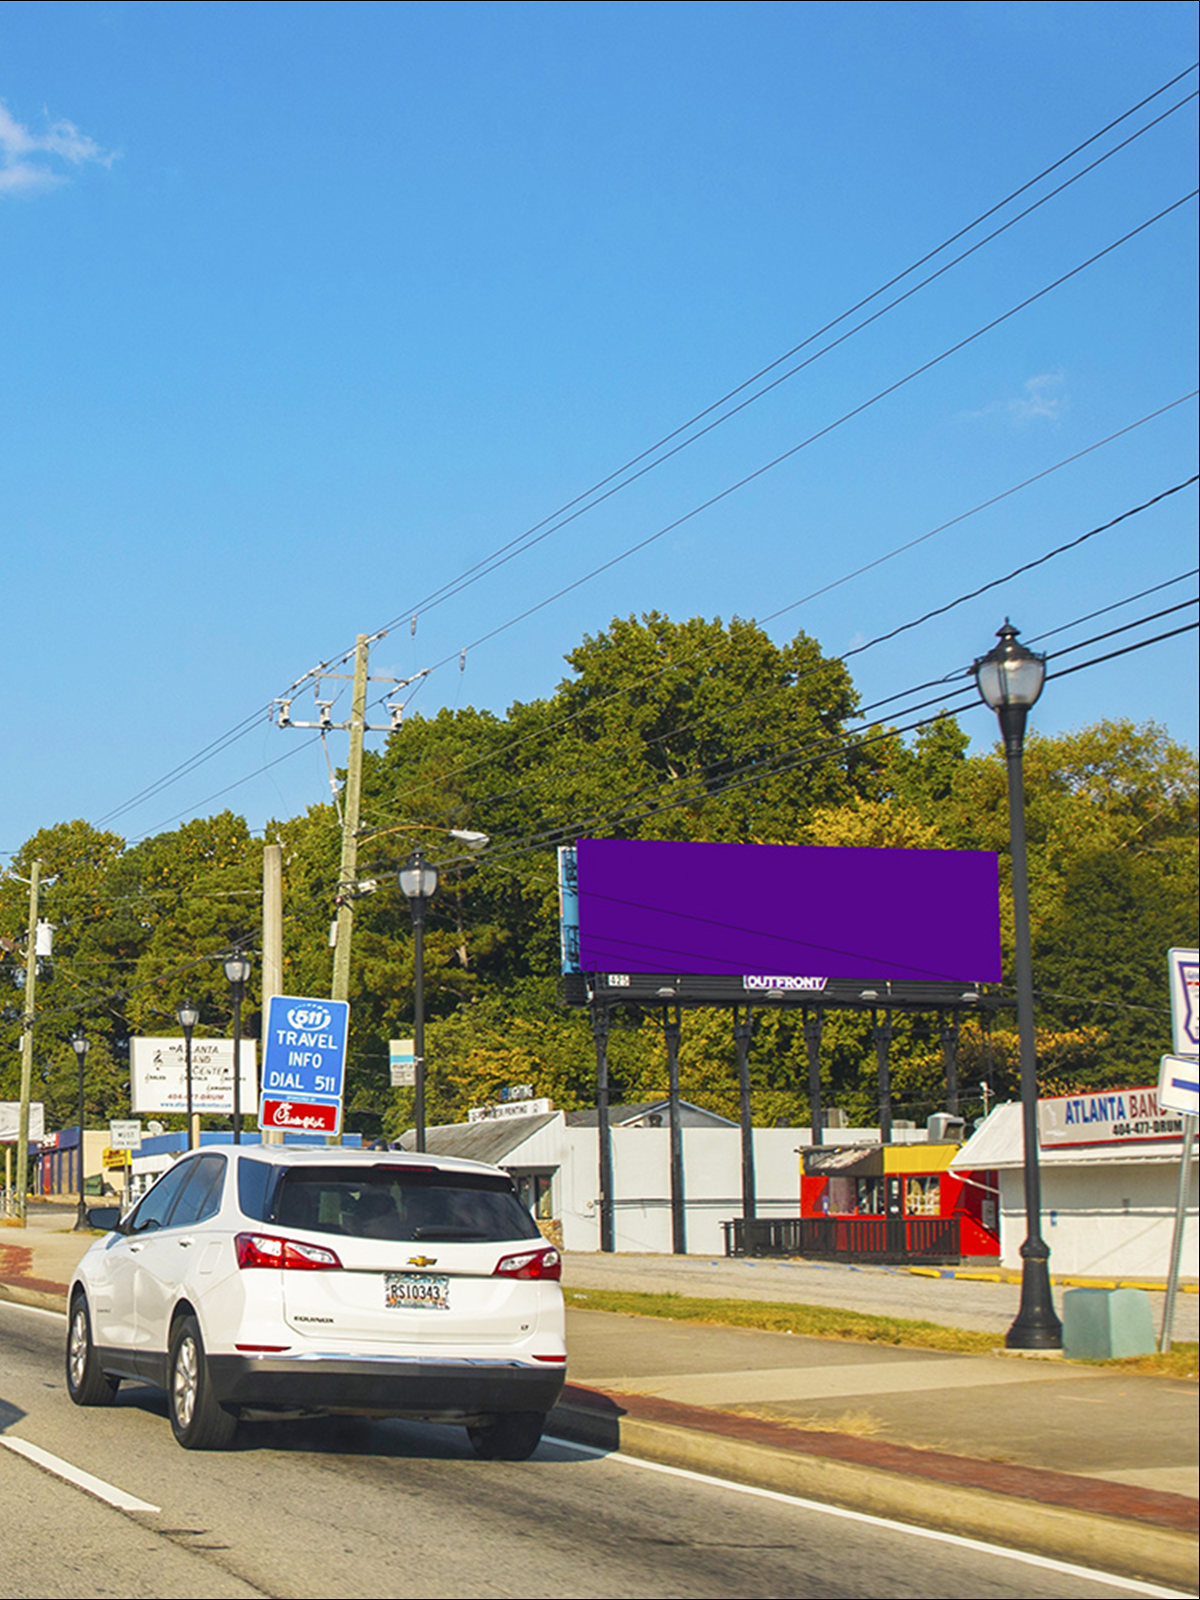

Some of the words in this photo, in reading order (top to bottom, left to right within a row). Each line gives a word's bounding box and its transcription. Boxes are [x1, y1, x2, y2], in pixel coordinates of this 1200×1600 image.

[746, 975, 824, 989] OUTFRONT
[294, 1009, 323, 1026] 511
[276, 1029, 338, 1050] TRAVEL
[288, 1051, 322, 1069] INFO
[269, 1071, 304, 1089] DIAL
[314, 1075, 335, 1092] 511
[1064, 1096, 1126, 1125] ATLANTA
[1112, 1119, 1183, 1136] 404-477-DRUM
[294, 1315, 335, 1324] EQUINOX
